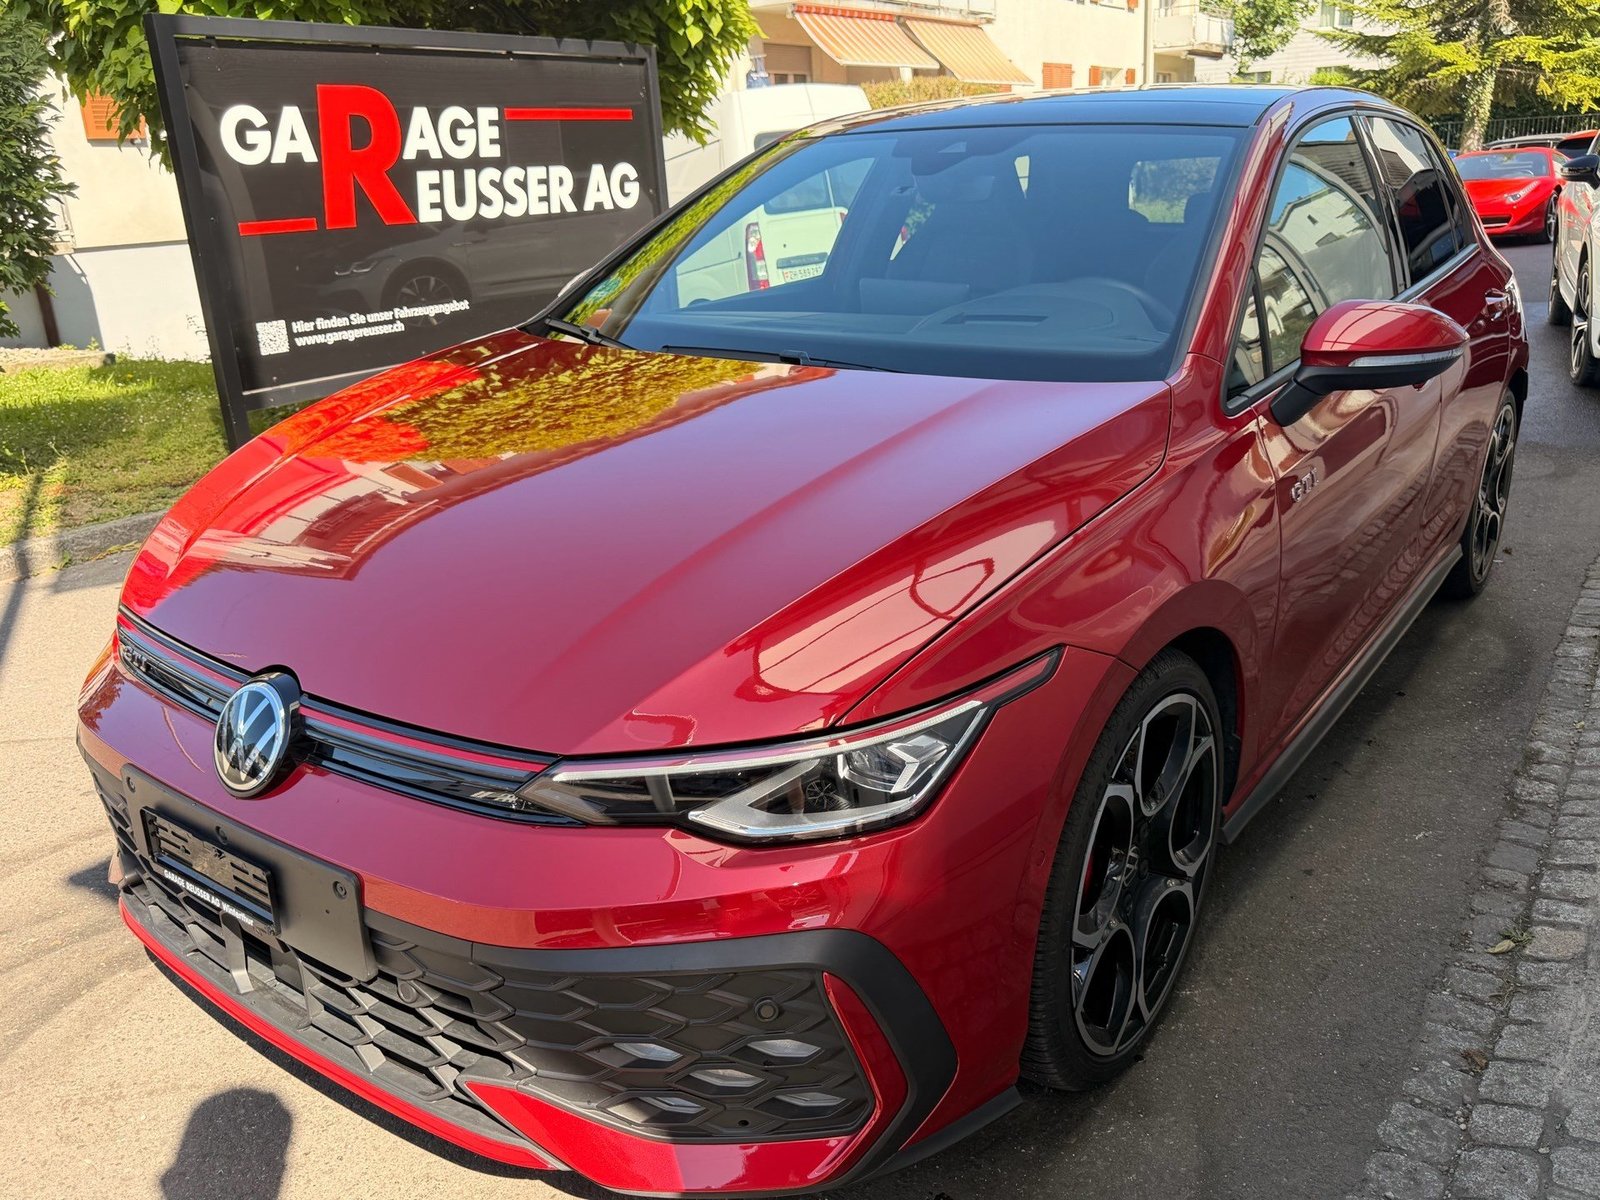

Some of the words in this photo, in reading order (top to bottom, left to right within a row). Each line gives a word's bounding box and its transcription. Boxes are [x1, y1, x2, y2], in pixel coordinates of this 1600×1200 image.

[220, 84, 501, 229] GARAGE
[583, 162, 640, 210] AG
[291, 320, 315, 333] Hier
[315, 316, 349, 330] finden
[350, 312, 366, 325] Sie
[367, 310, 394, 323] unser
[393, 299, 470, 319] Fahrzeugangebot
[294, 321, 405, 347] www.garagereusser.ch
[163, 869, 186, 887] GARAGE
